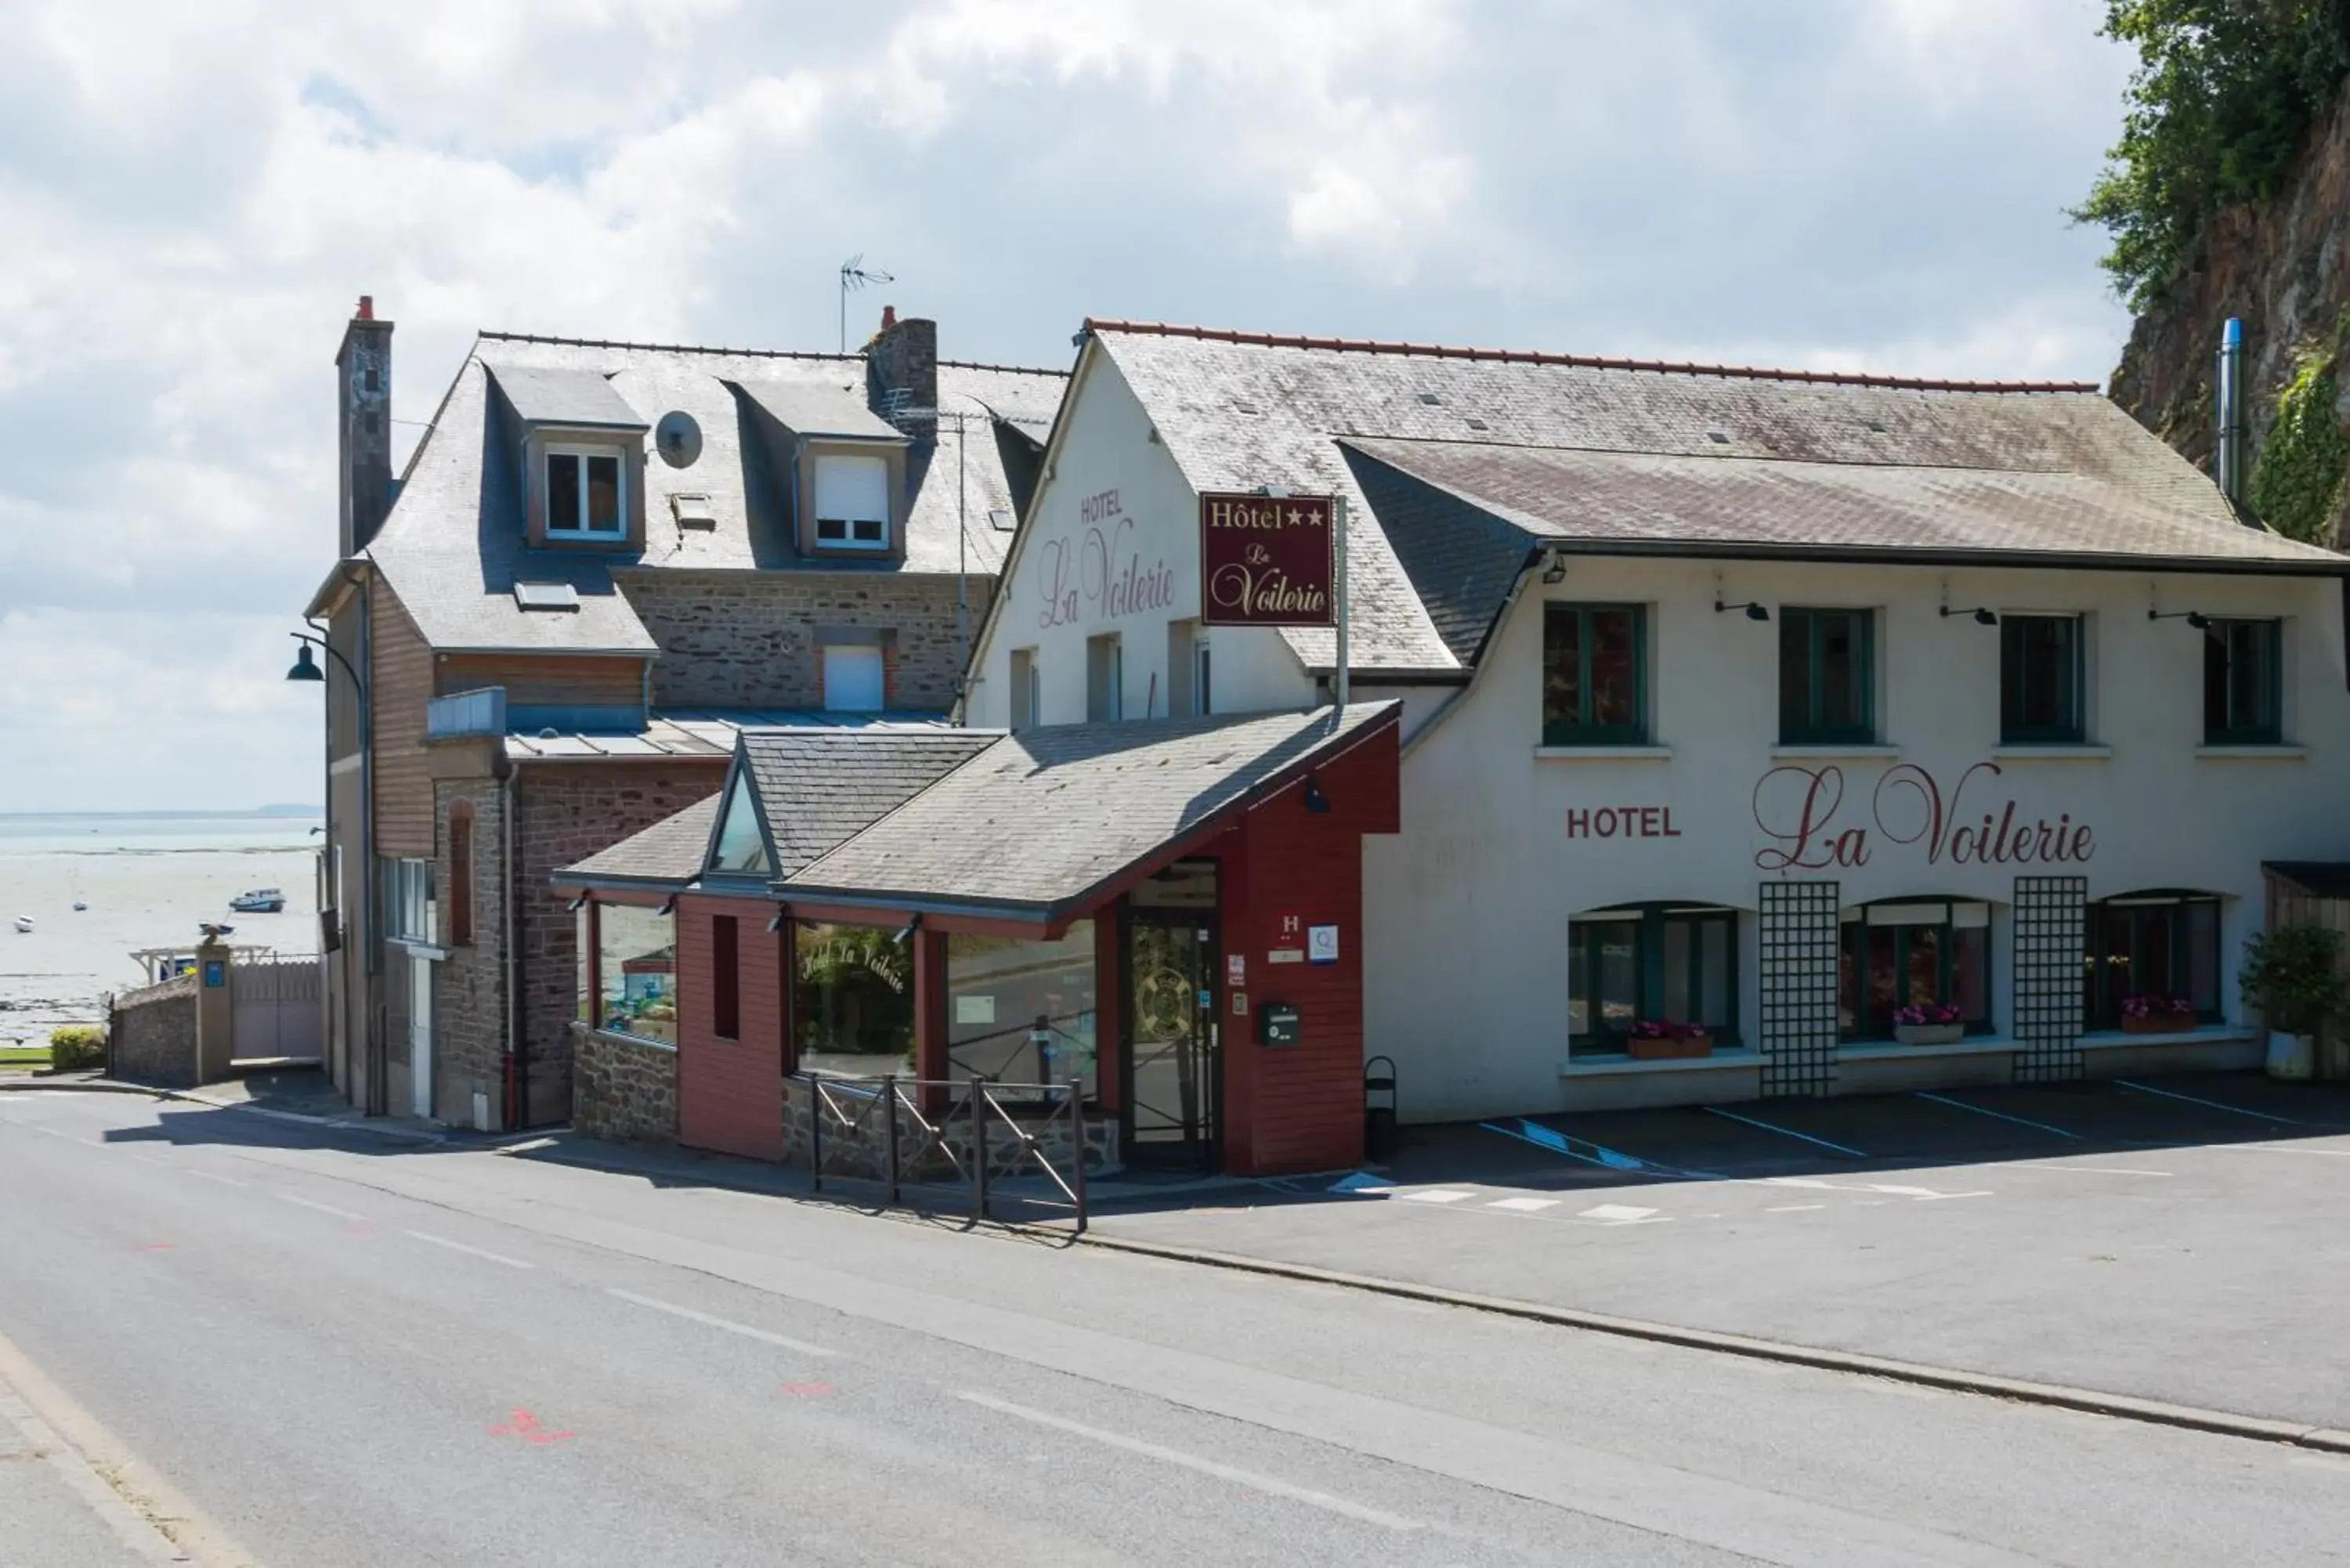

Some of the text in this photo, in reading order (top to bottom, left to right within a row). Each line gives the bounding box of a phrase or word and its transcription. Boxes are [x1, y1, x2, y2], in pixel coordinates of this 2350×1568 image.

[1081, 488, 1123, 524] HOTEL
[1211, 502, 1283, 529] Hôtel
[1246, 543, 1271, 564] La
[1039, 517, 1174, 628] La Voilerie
[1211, 563, 1325, 616] Voilerie
[1567, 807, 1681, 839] HOTEL
[1752, 763, 2095, 871] La Voilerie
[1283, 916, 1300, 932] H
